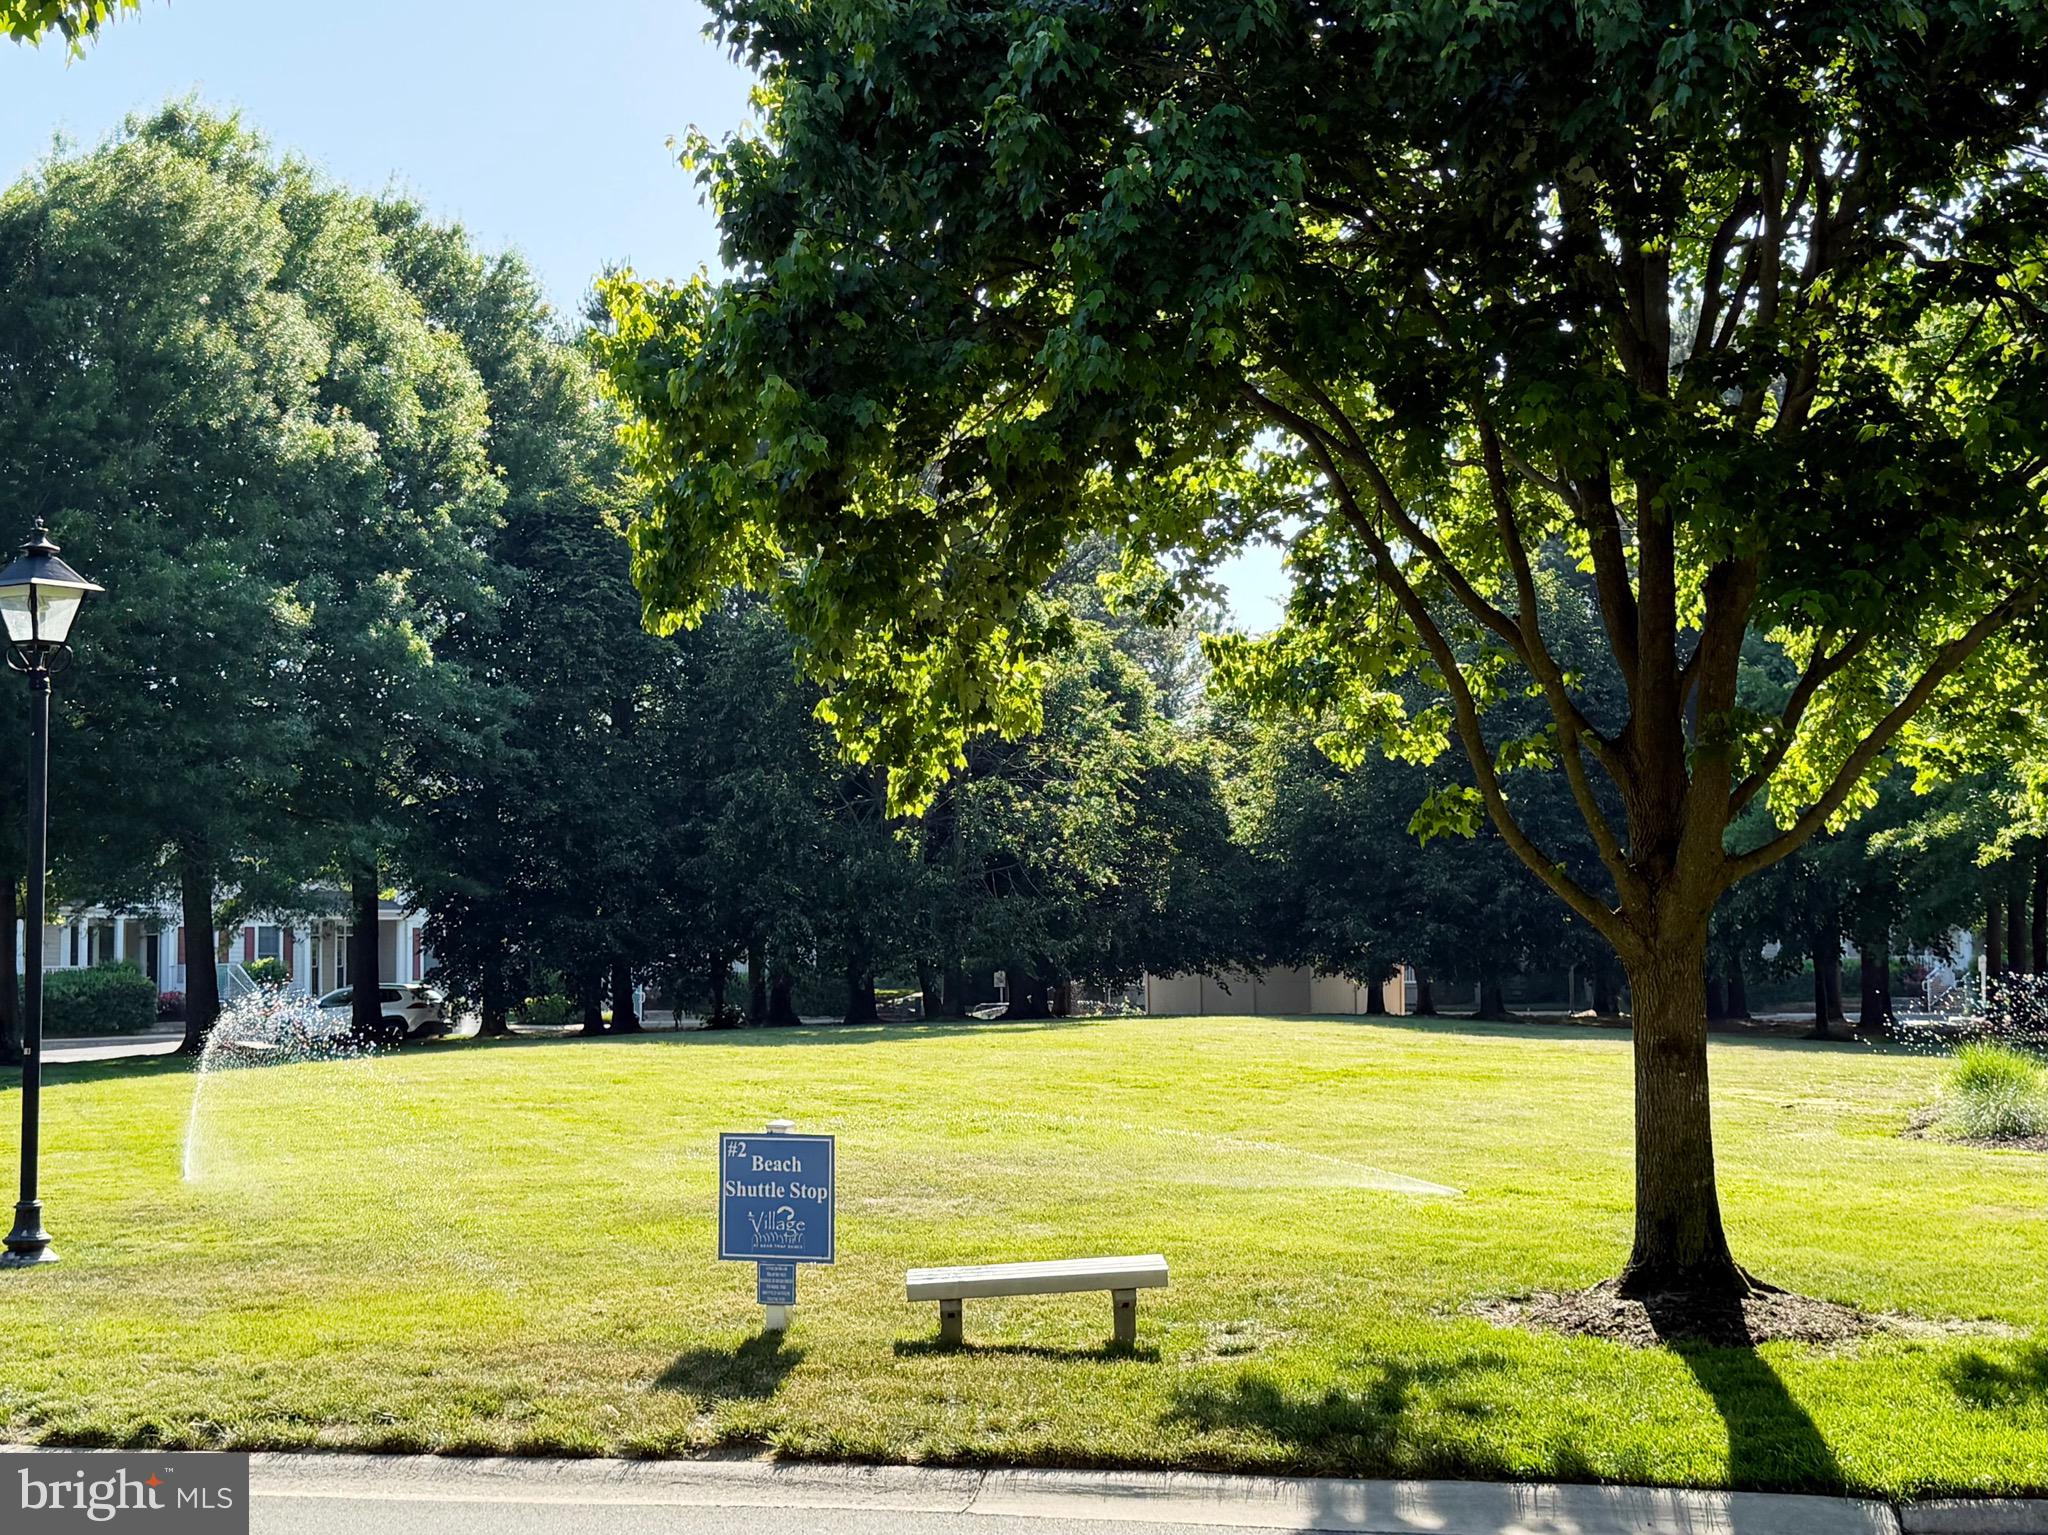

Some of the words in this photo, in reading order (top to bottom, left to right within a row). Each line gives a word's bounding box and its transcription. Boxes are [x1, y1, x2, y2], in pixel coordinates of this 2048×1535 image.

[727, 1141, 747, 1158] #2
[751, 1155, 802, 1173] Beach
[725, 1180, 785, 1198] Shuttle
[790, 1182, 828, 1204] Stop
[748, 1210, 806, 1237] Village
